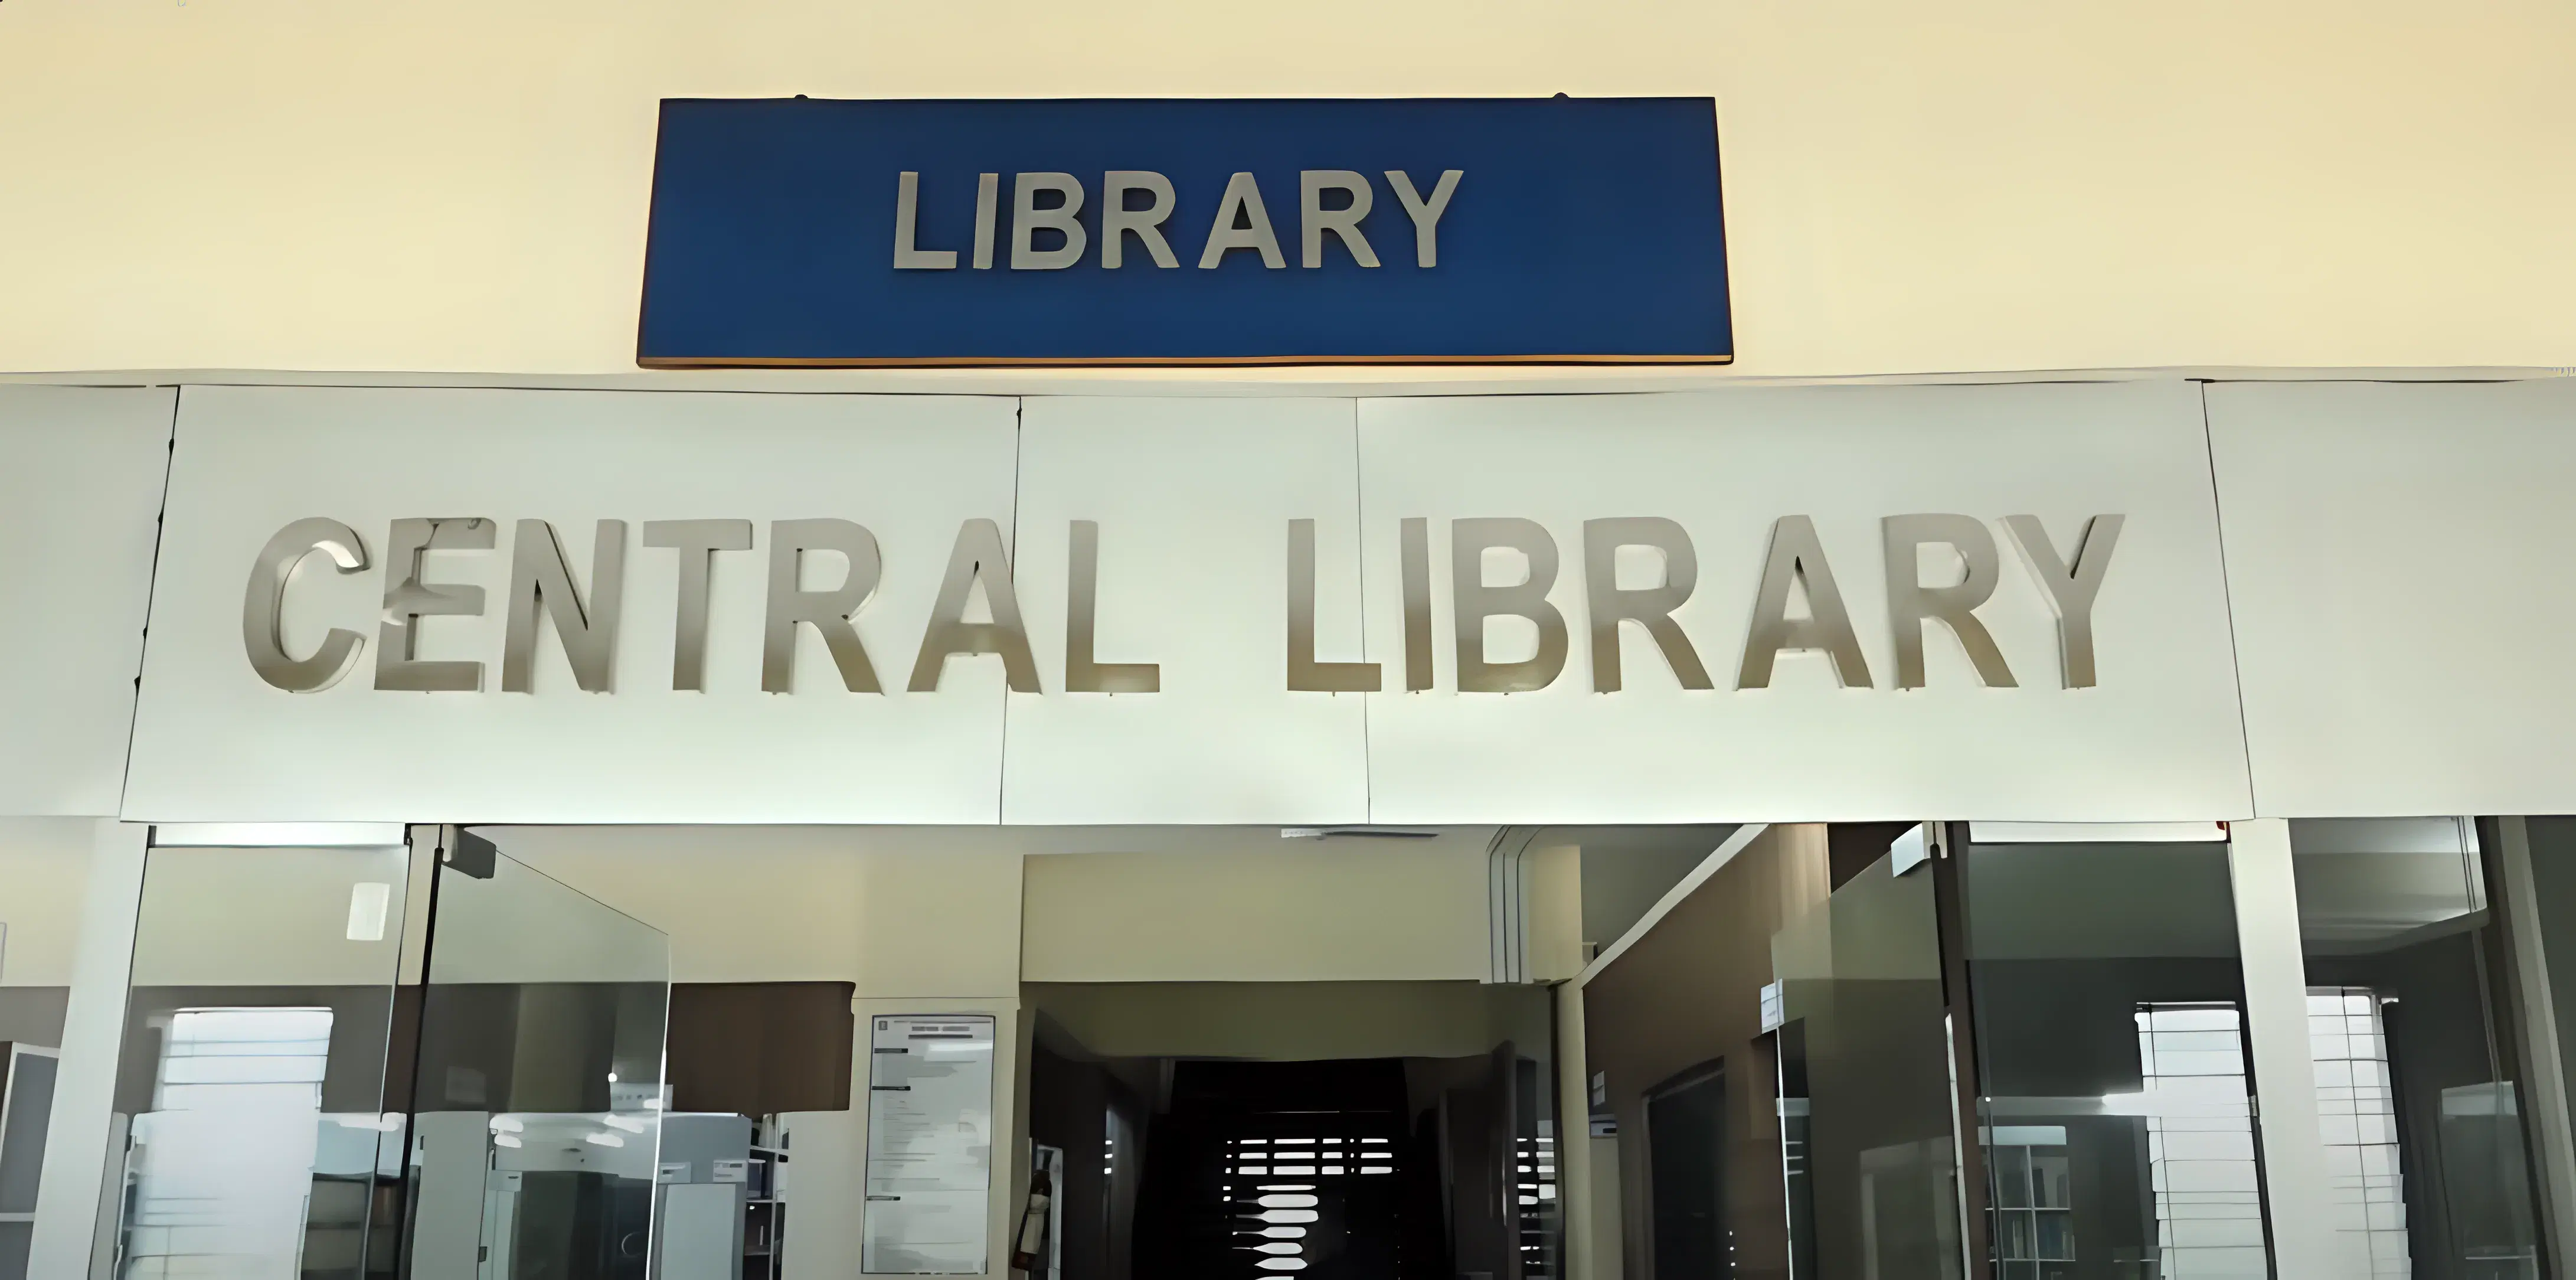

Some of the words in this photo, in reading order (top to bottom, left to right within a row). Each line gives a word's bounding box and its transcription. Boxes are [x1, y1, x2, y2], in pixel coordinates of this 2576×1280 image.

[893, 169, 1464, 270] LIBRARY
[243, 517, 1160, 695] CENTRAL
[1287, 514, 2126, 693] LIBRARY
